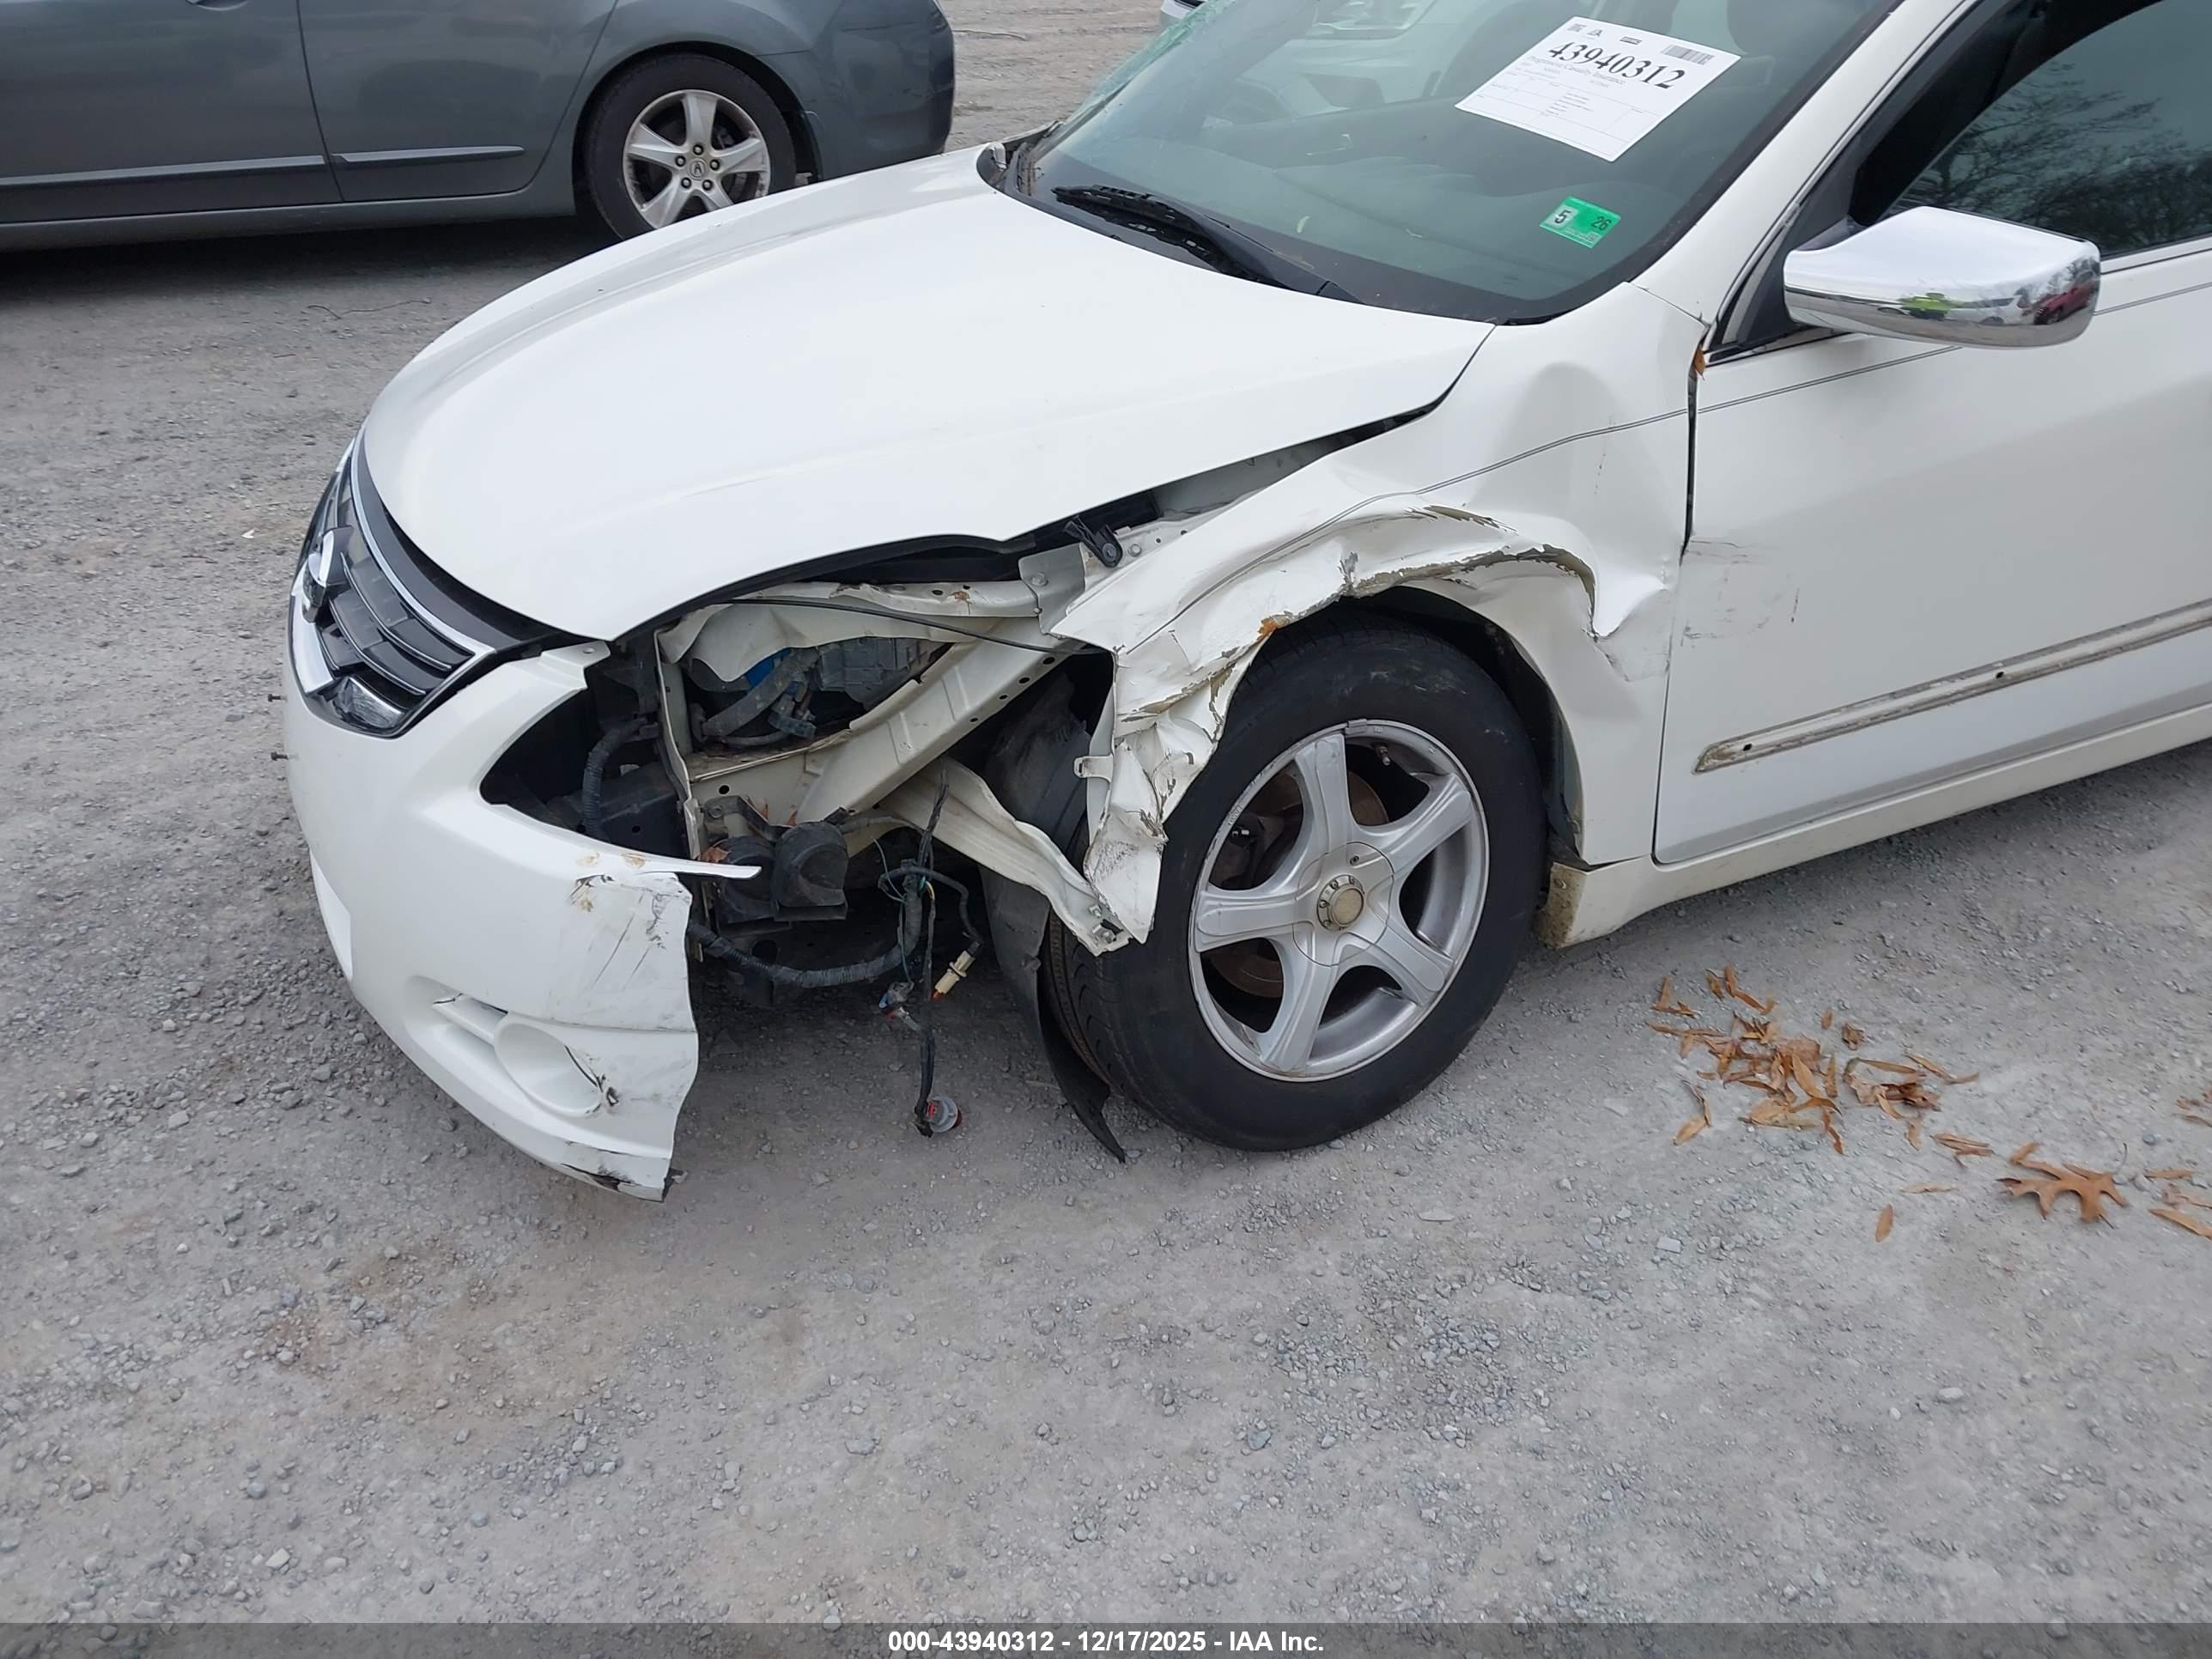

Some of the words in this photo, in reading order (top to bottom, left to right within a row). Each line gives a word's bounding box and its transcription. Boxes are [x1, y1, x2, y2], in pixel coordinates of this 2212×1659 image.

[1549, 41, 1686, 89] 43940312
[1554, 210, 1572, 224] 5
[1590, 216, 1613, 231] 26
